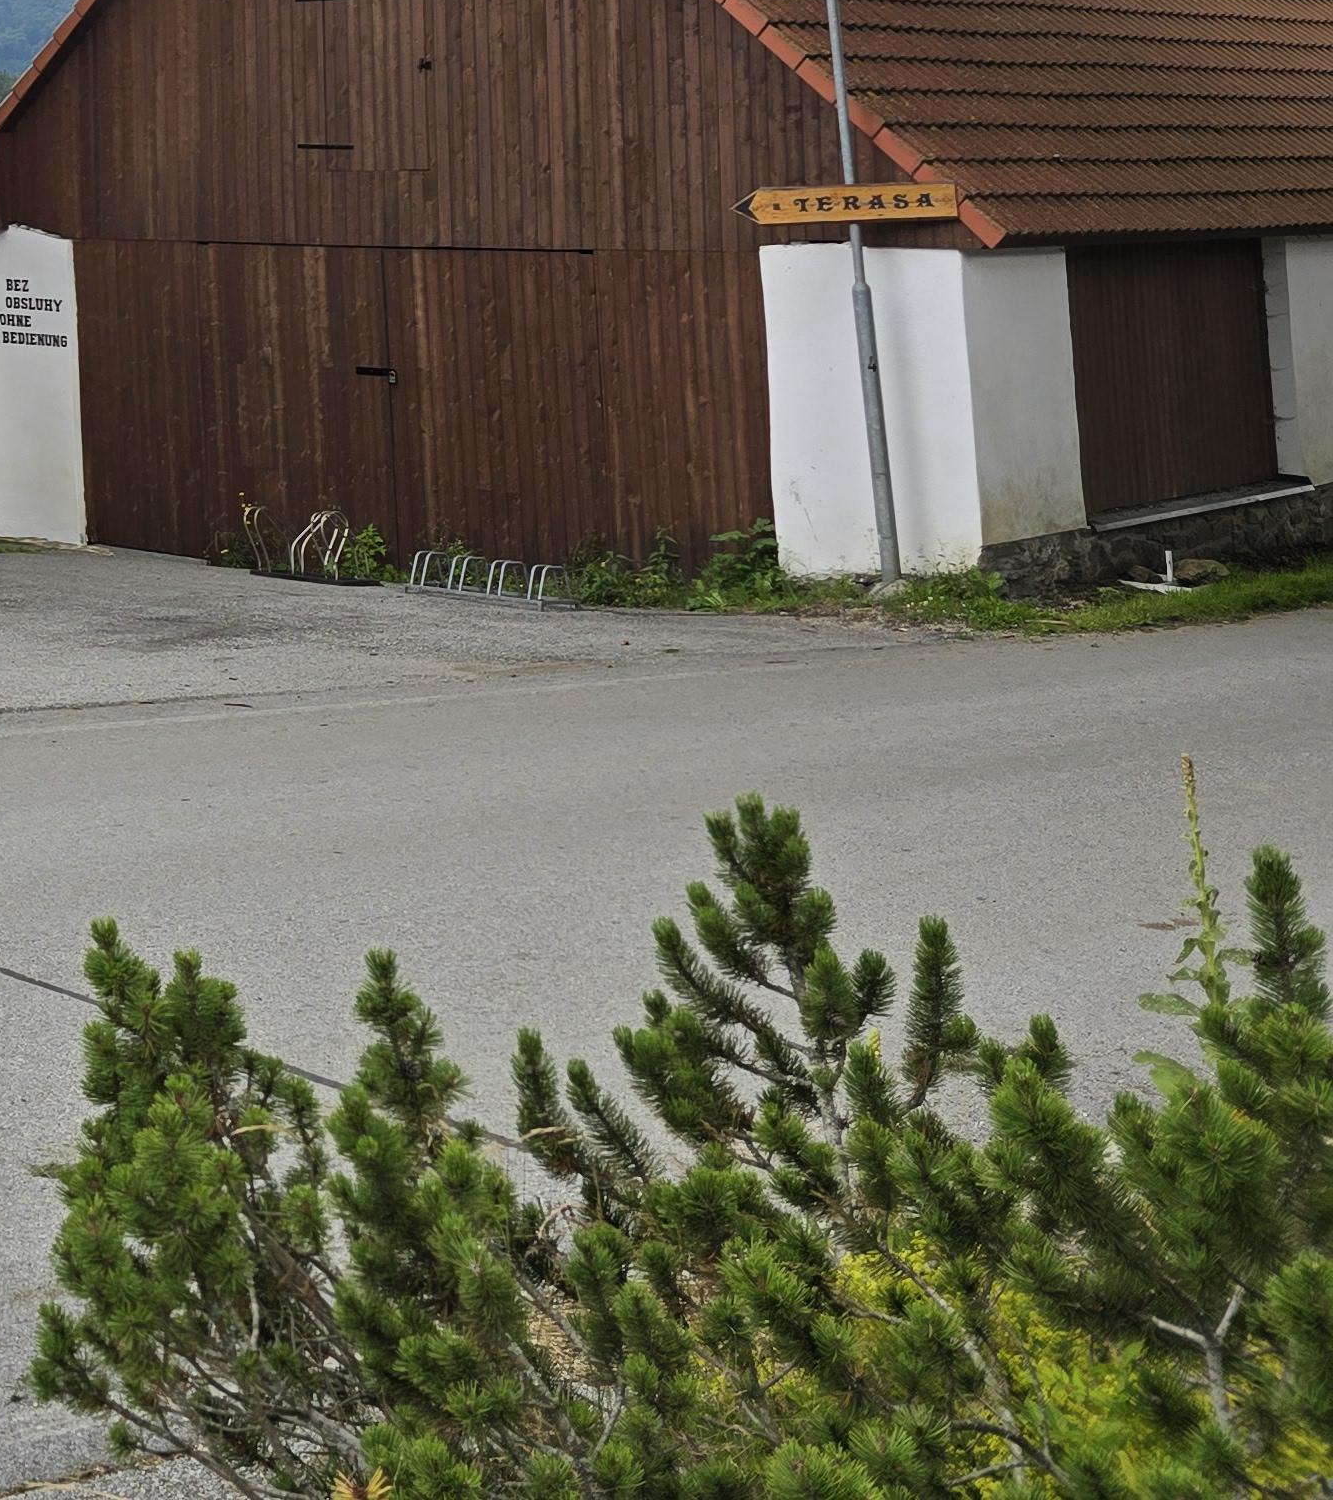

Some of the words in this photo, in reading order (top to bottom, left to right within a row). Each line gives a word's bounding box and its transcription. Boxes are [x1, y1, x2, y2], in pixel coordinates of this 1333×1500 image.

[793, 192, 935, 212] TERASA
[6, 279, 29, 292] BEZ
[5, 297, 62, 312] OBSLUHY
[0, 314, 32, 327] OHNE
[2, 331, 68, 347] BEDIENUNG
